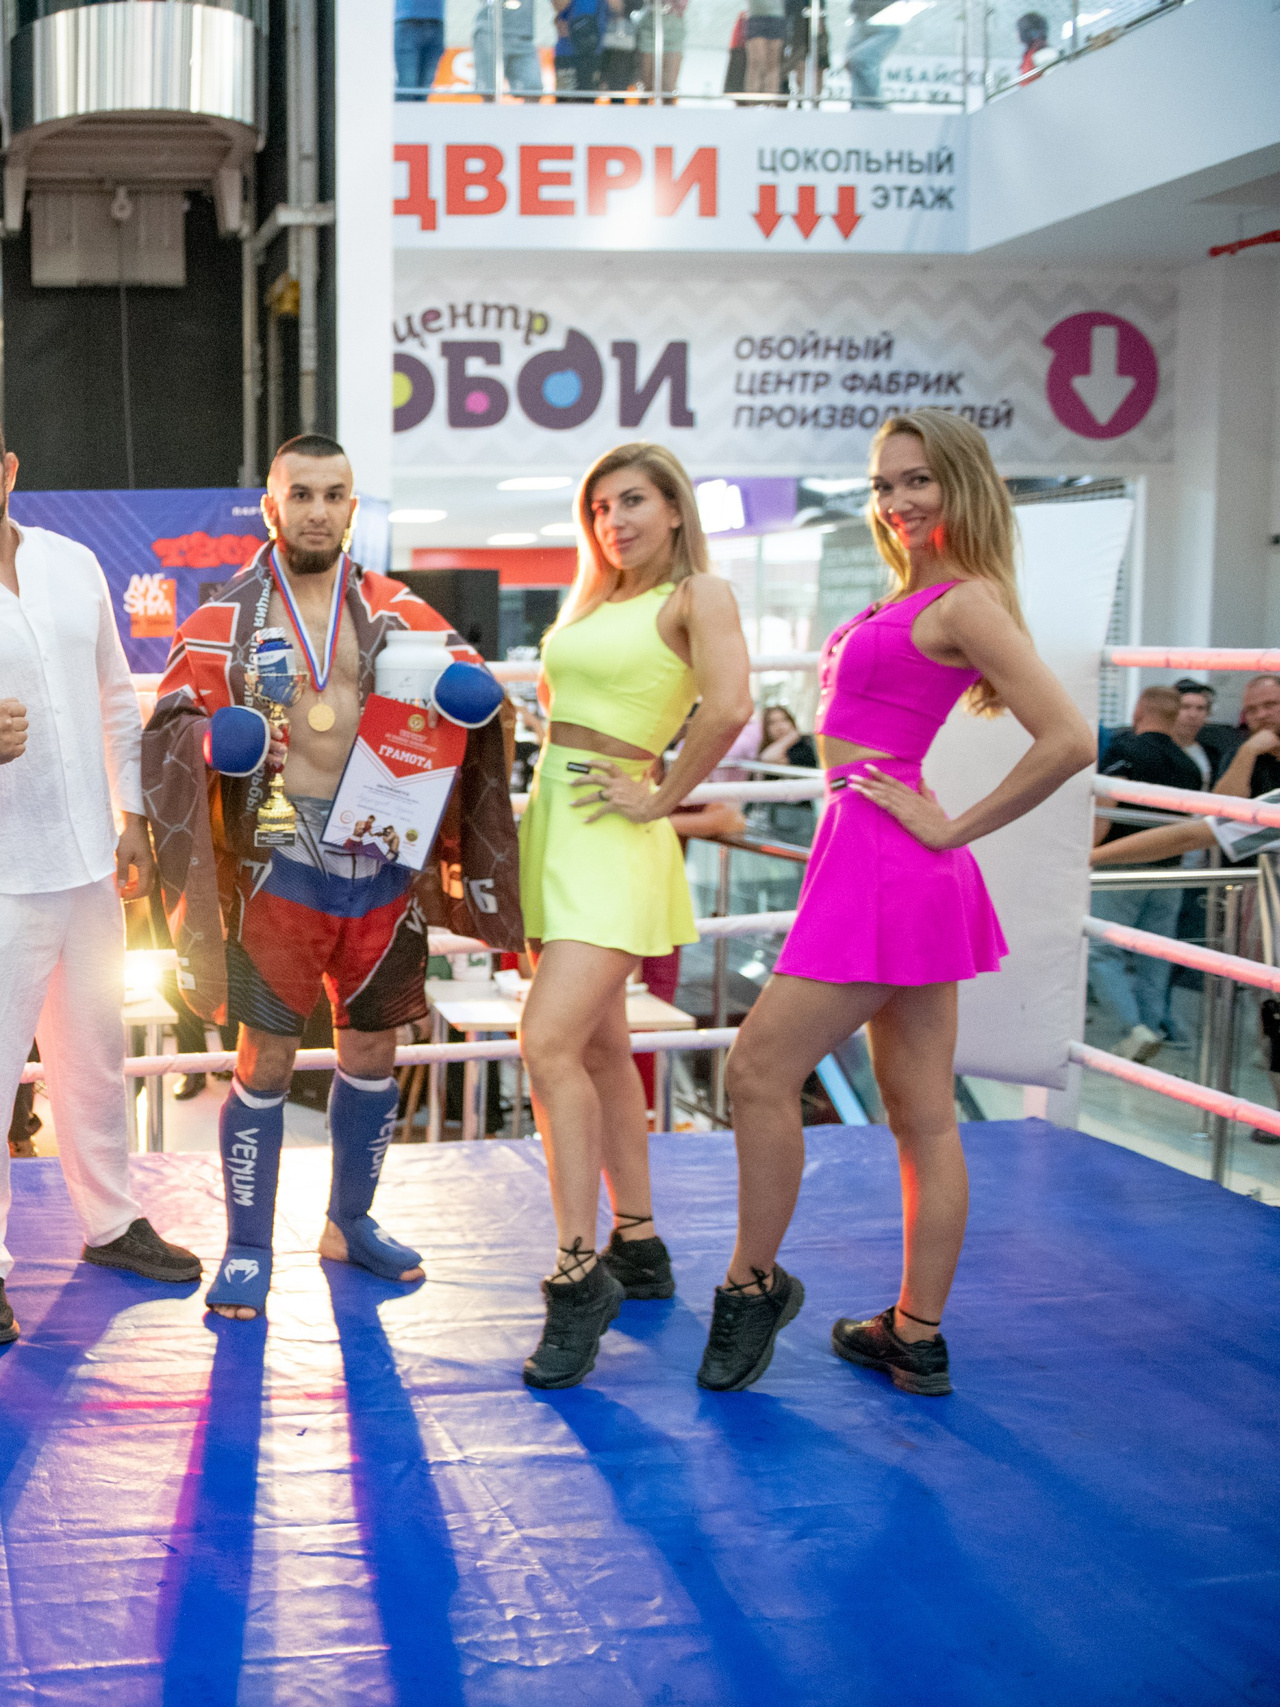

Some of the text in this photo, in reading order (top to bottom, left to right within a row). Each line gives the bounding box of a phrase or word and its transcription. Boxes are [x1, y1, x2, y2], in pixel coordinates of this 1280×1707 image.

[758, 146, 955, 175] ЦОКОЛЬНЫЙ
[393, 144, 718, 231] ДВЕРИ
[871, 186, 955, 210] ЭТАЖ
[393, 302, 550, 348] центр
[734, 331, 894, 360] ОБОЙНЫЙ
[734, 371, 964, 397] ЦЕНТР ФАБРИК
[379, 745, 433, 770] ГРАМОТА
[226, 1127, 260, 1207] VENUM
